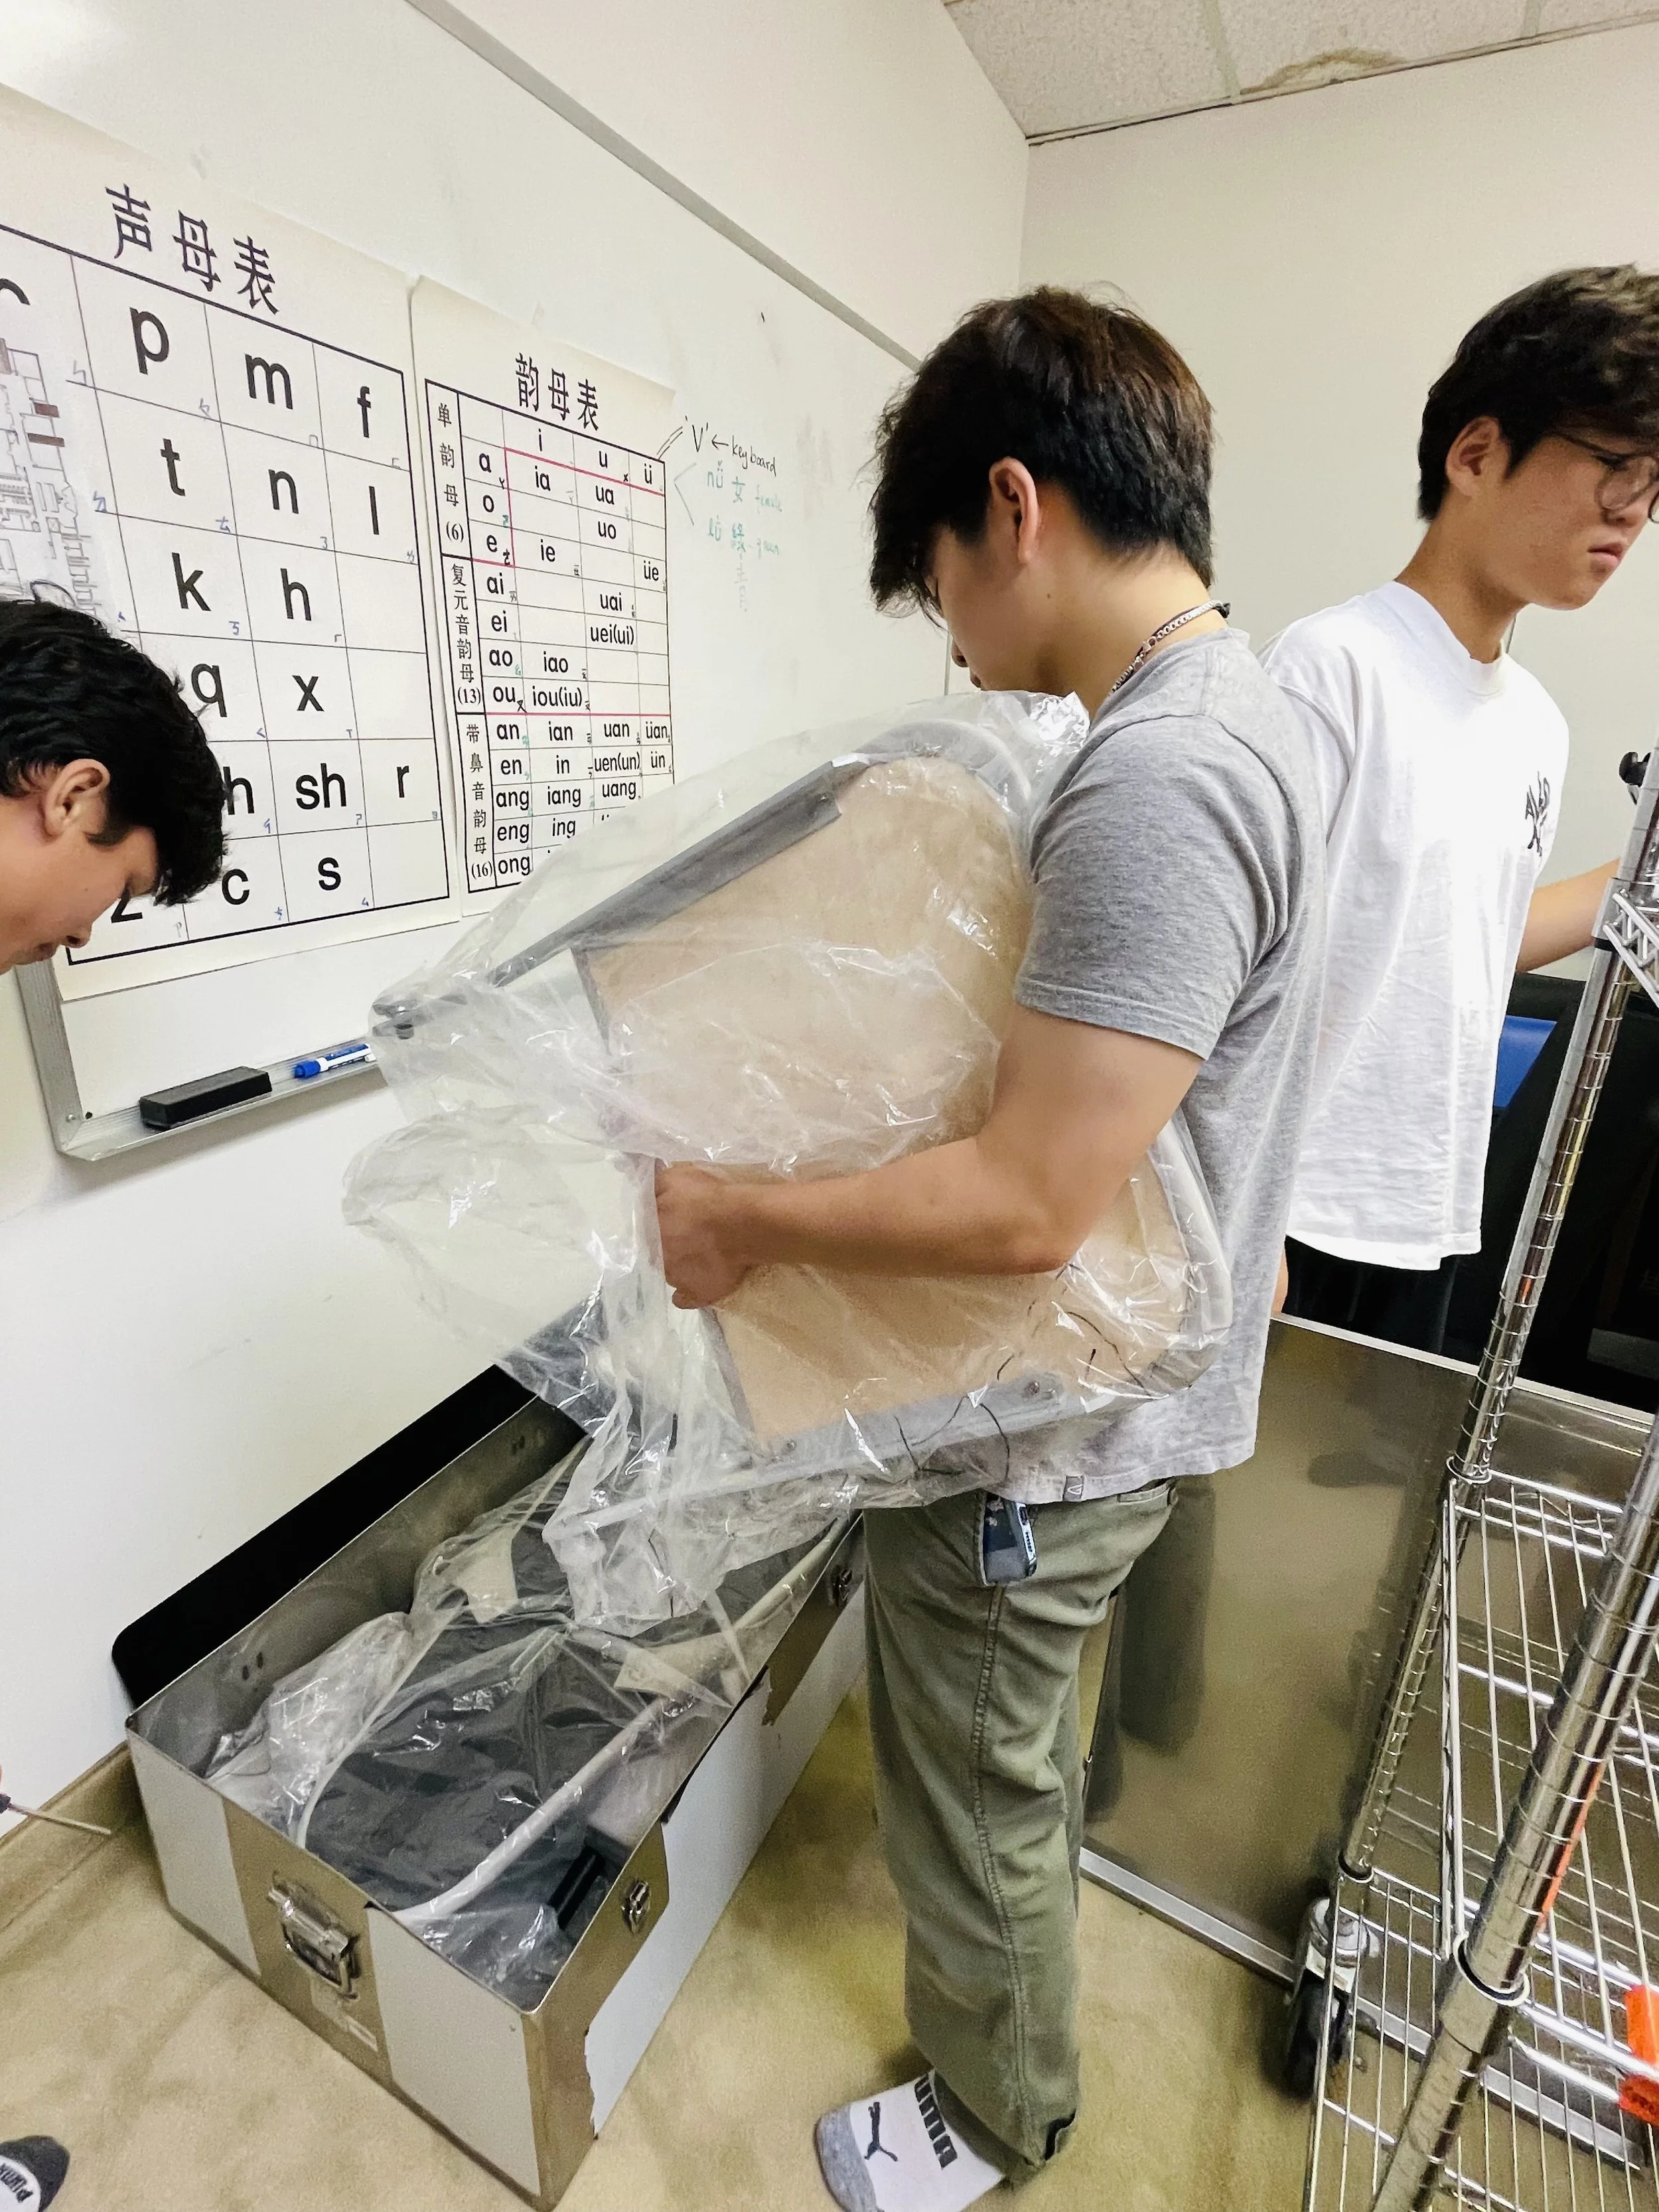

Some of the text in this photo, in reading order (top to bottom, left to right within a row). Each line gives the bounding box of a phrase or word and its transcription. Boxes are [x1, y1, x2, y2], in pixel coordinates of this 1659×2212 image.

[105, 184, 279, 315] 声母表
[130, 307, 371, 438] p m f
[515, 352, 599, 431] 韵母表
[479, 453, 492, 473] a
[535, 465, 551, 492] ia
[595, 485, 614, 505] ua
[538, 428, 652, 485] i u ü
[161, 439, 379, 535] t n l
[483, 494, 616, 540] o uo
[486, 534, 659, 581] e ie üe
[172, 552, 311, 621] k h
[486, 572, 504, 595] ai
[600, 592, 622, 611] uai
[491, 610, 634, 645] ei uei(ui)
[489, 649, 569, 673] ao iao
[190, 664, 324, 717] q x
[492, 685, 583, 707] ou iou(iu)
[496, 723, 520, 740] an
[548, 721, 573, 741] ian
[604, 723, 630, 737] uan
[645, 721, 668, 739] üan
[500, 759, 522, 775] en
[556, 755, 570, 774] in
[594, 751, 640, 772] uen(un)
[650, 751, 666, 769] ün
[223, 763, 409, 815] h sh r
[496, 790, 530, 811] ang
[547, 785, 581, 808] iang
[602, 782, 636, 800] uang
[497, 817, 576, 844] eng ing
[221, 869, 250, 905] c
[319, 857, 340, 891] s
[498, 856, 530, 876] ong
